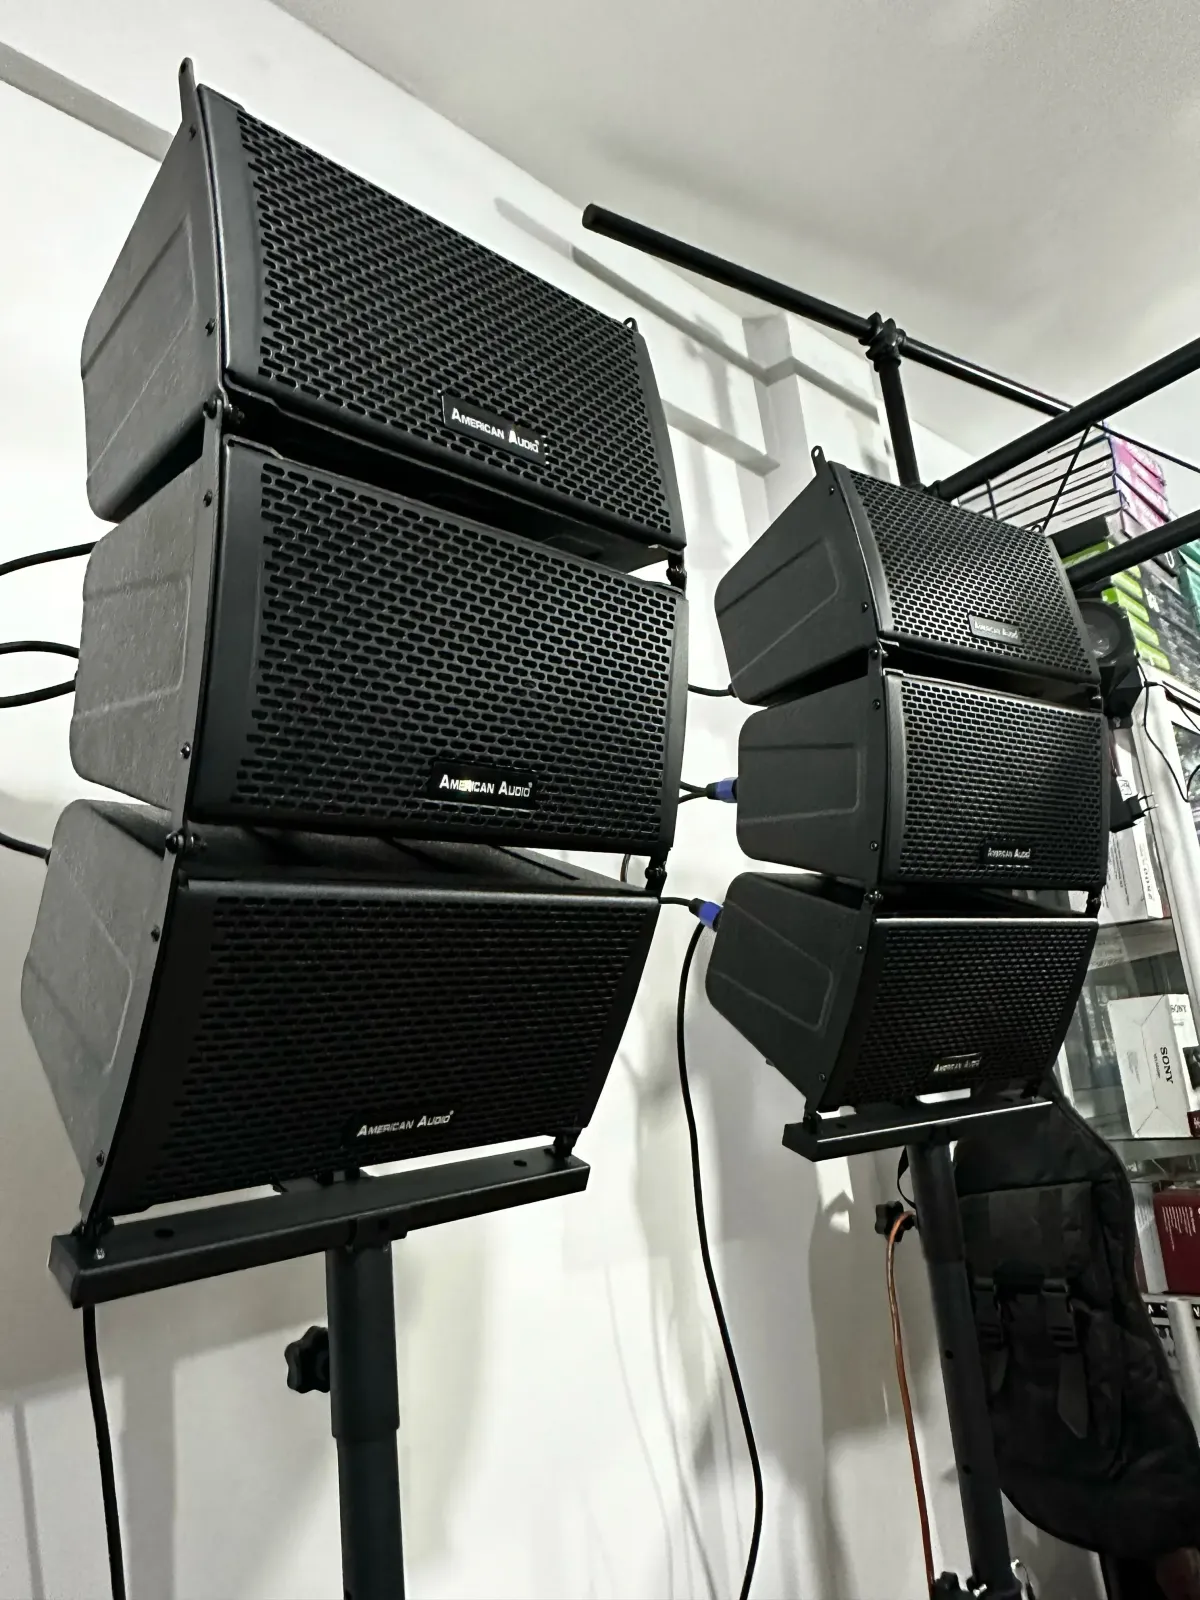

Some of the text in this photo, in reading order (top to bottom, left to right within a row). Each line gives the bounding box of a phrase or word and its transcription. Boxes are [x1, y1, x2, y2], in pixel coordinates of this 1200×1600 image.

[452, 407, 505, 439] AMERICAN
[439, 774, 531, 797] AMERICAN AUDIO
[1160, 1046, 1174, 1084] SONY
[356, 1115, 451, 1137] AMERICAN AUDIO
